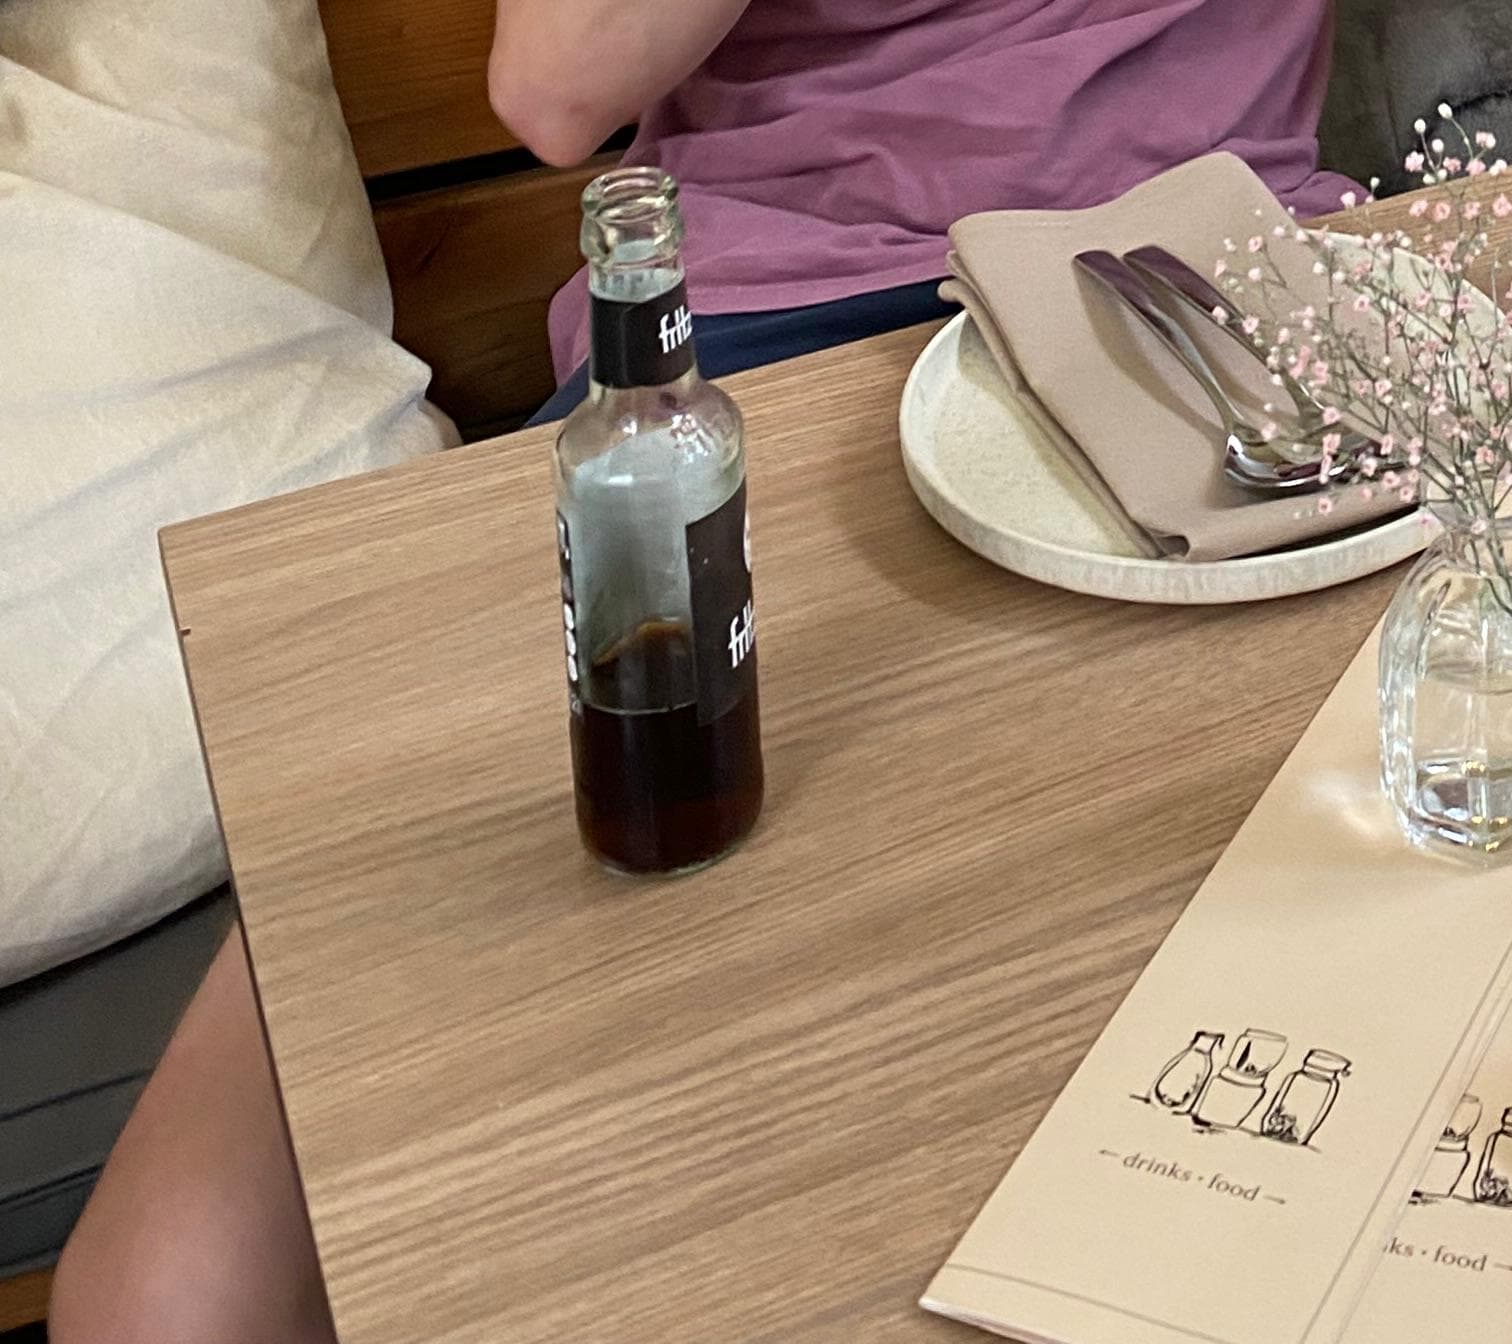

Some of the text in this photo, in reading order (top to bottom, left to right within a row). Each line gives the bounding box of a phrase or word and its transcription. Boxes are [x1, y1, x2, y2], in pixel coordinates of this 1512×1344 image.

[1122, 1151, 1262, 1203] drinks food
[1382, 1236, 1488, 1272] ks food
